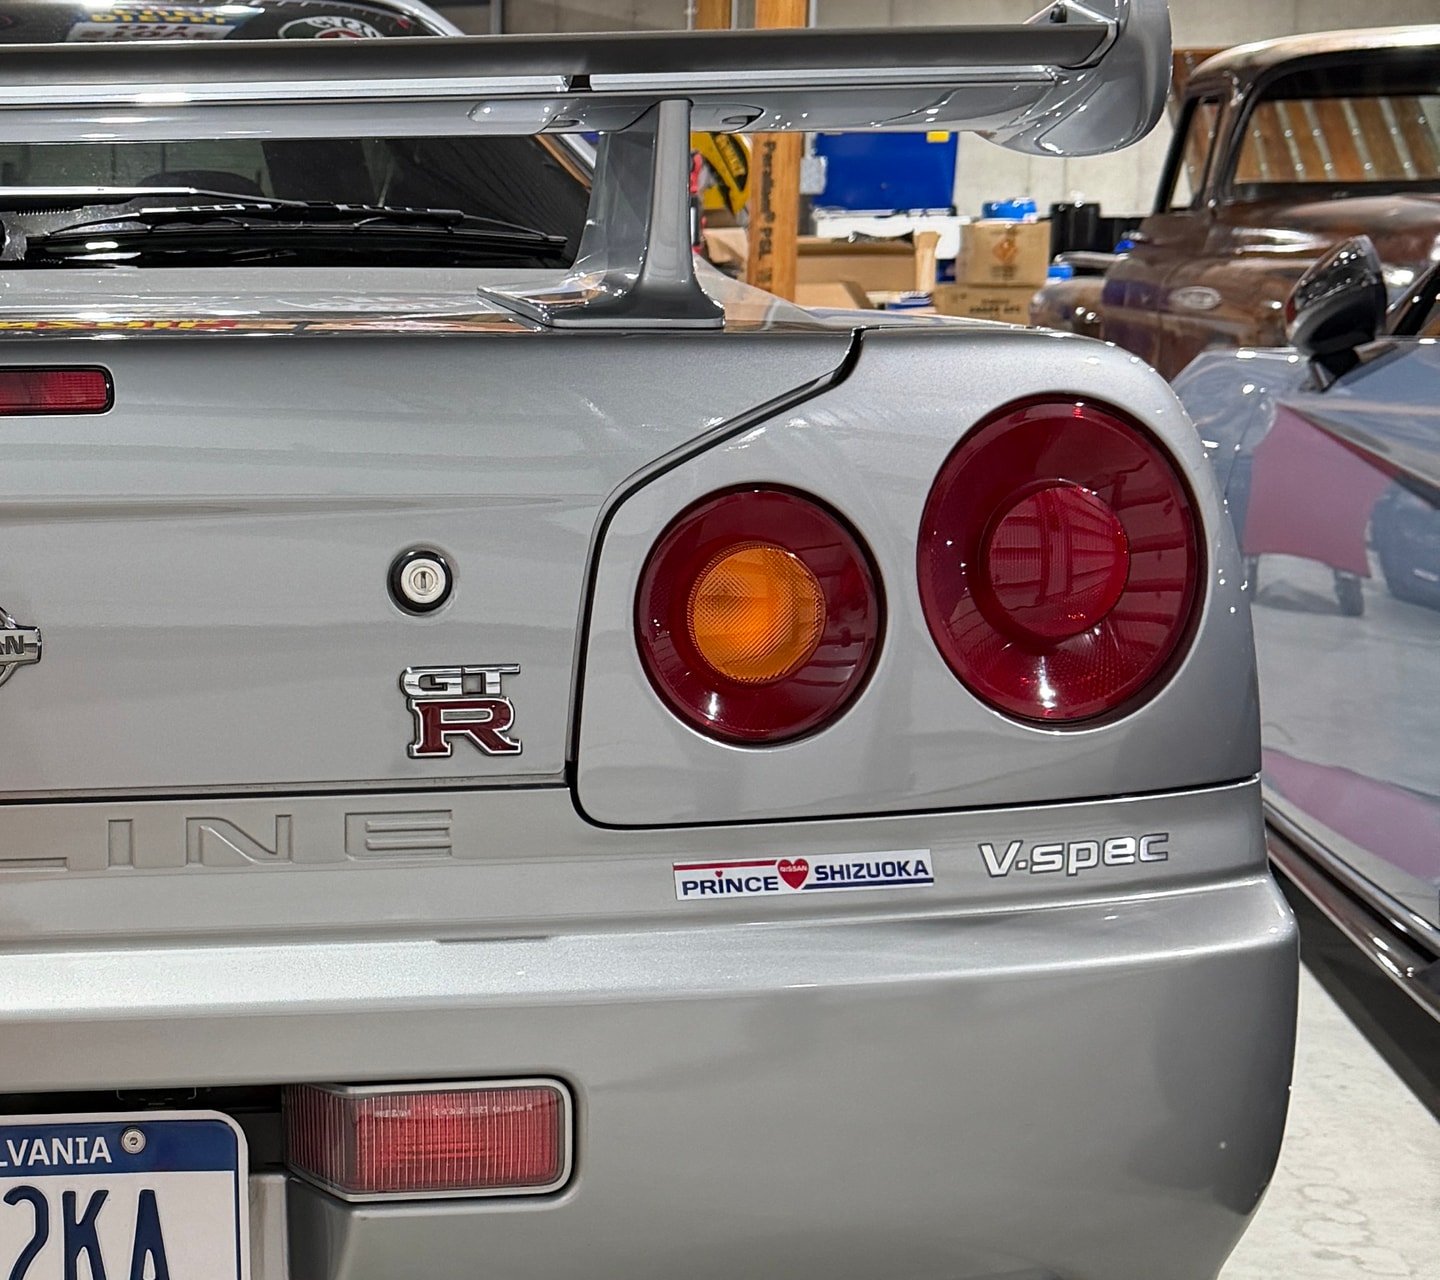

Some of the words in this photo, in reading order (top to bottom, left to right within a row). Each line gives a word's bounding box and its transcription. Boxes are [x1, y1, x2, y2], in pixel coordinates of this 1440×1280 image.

[400, 664, 521, 697] GT
[409, 697, 522, 759] R
[682, 870, 778, 896] PRINCE
[814, 859, 929, 882] SHIZUOKA
